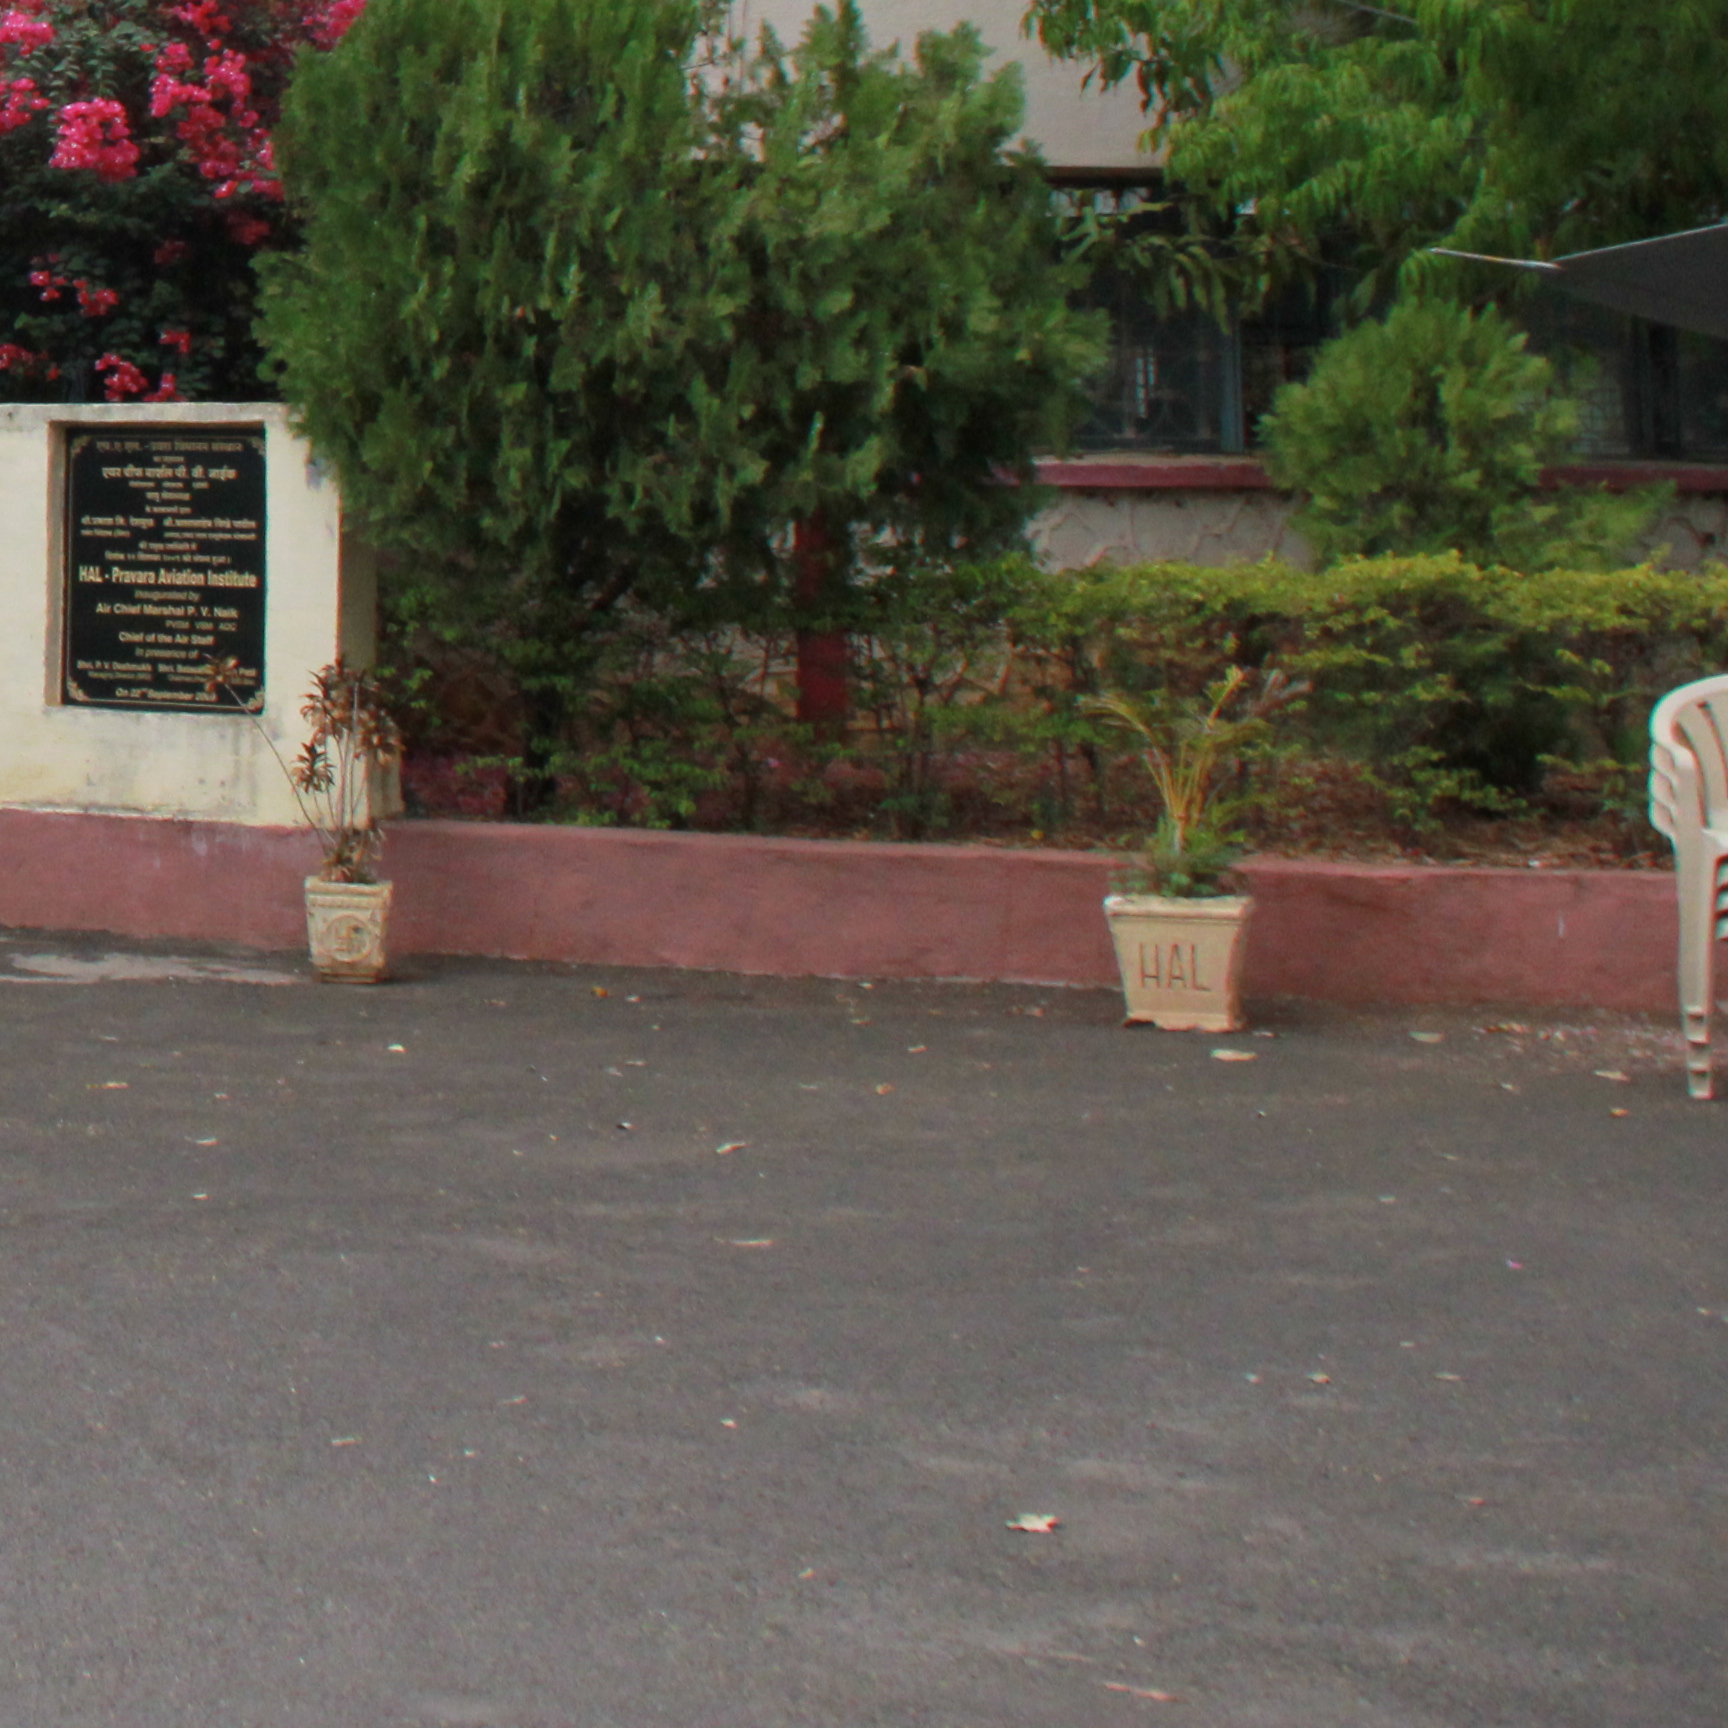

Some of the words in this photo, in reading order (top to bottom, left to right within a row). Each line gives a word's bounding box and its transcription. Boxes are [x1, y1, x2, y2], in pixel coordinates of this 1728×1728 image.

[78, 565, 103, 582] HAL
[112, 567, 155, 584] Pravara
[157, 568, 205, 585] Aviation
[207, 570, 257, 587] Institute
[96, 603, 111, 613] Air
[113, 603, 141, 614] Chief
[143, 604, 185, 616] Marshal
[118, 631, 144, 642] Chief
[1138, 942, 1213, 993] HAL
